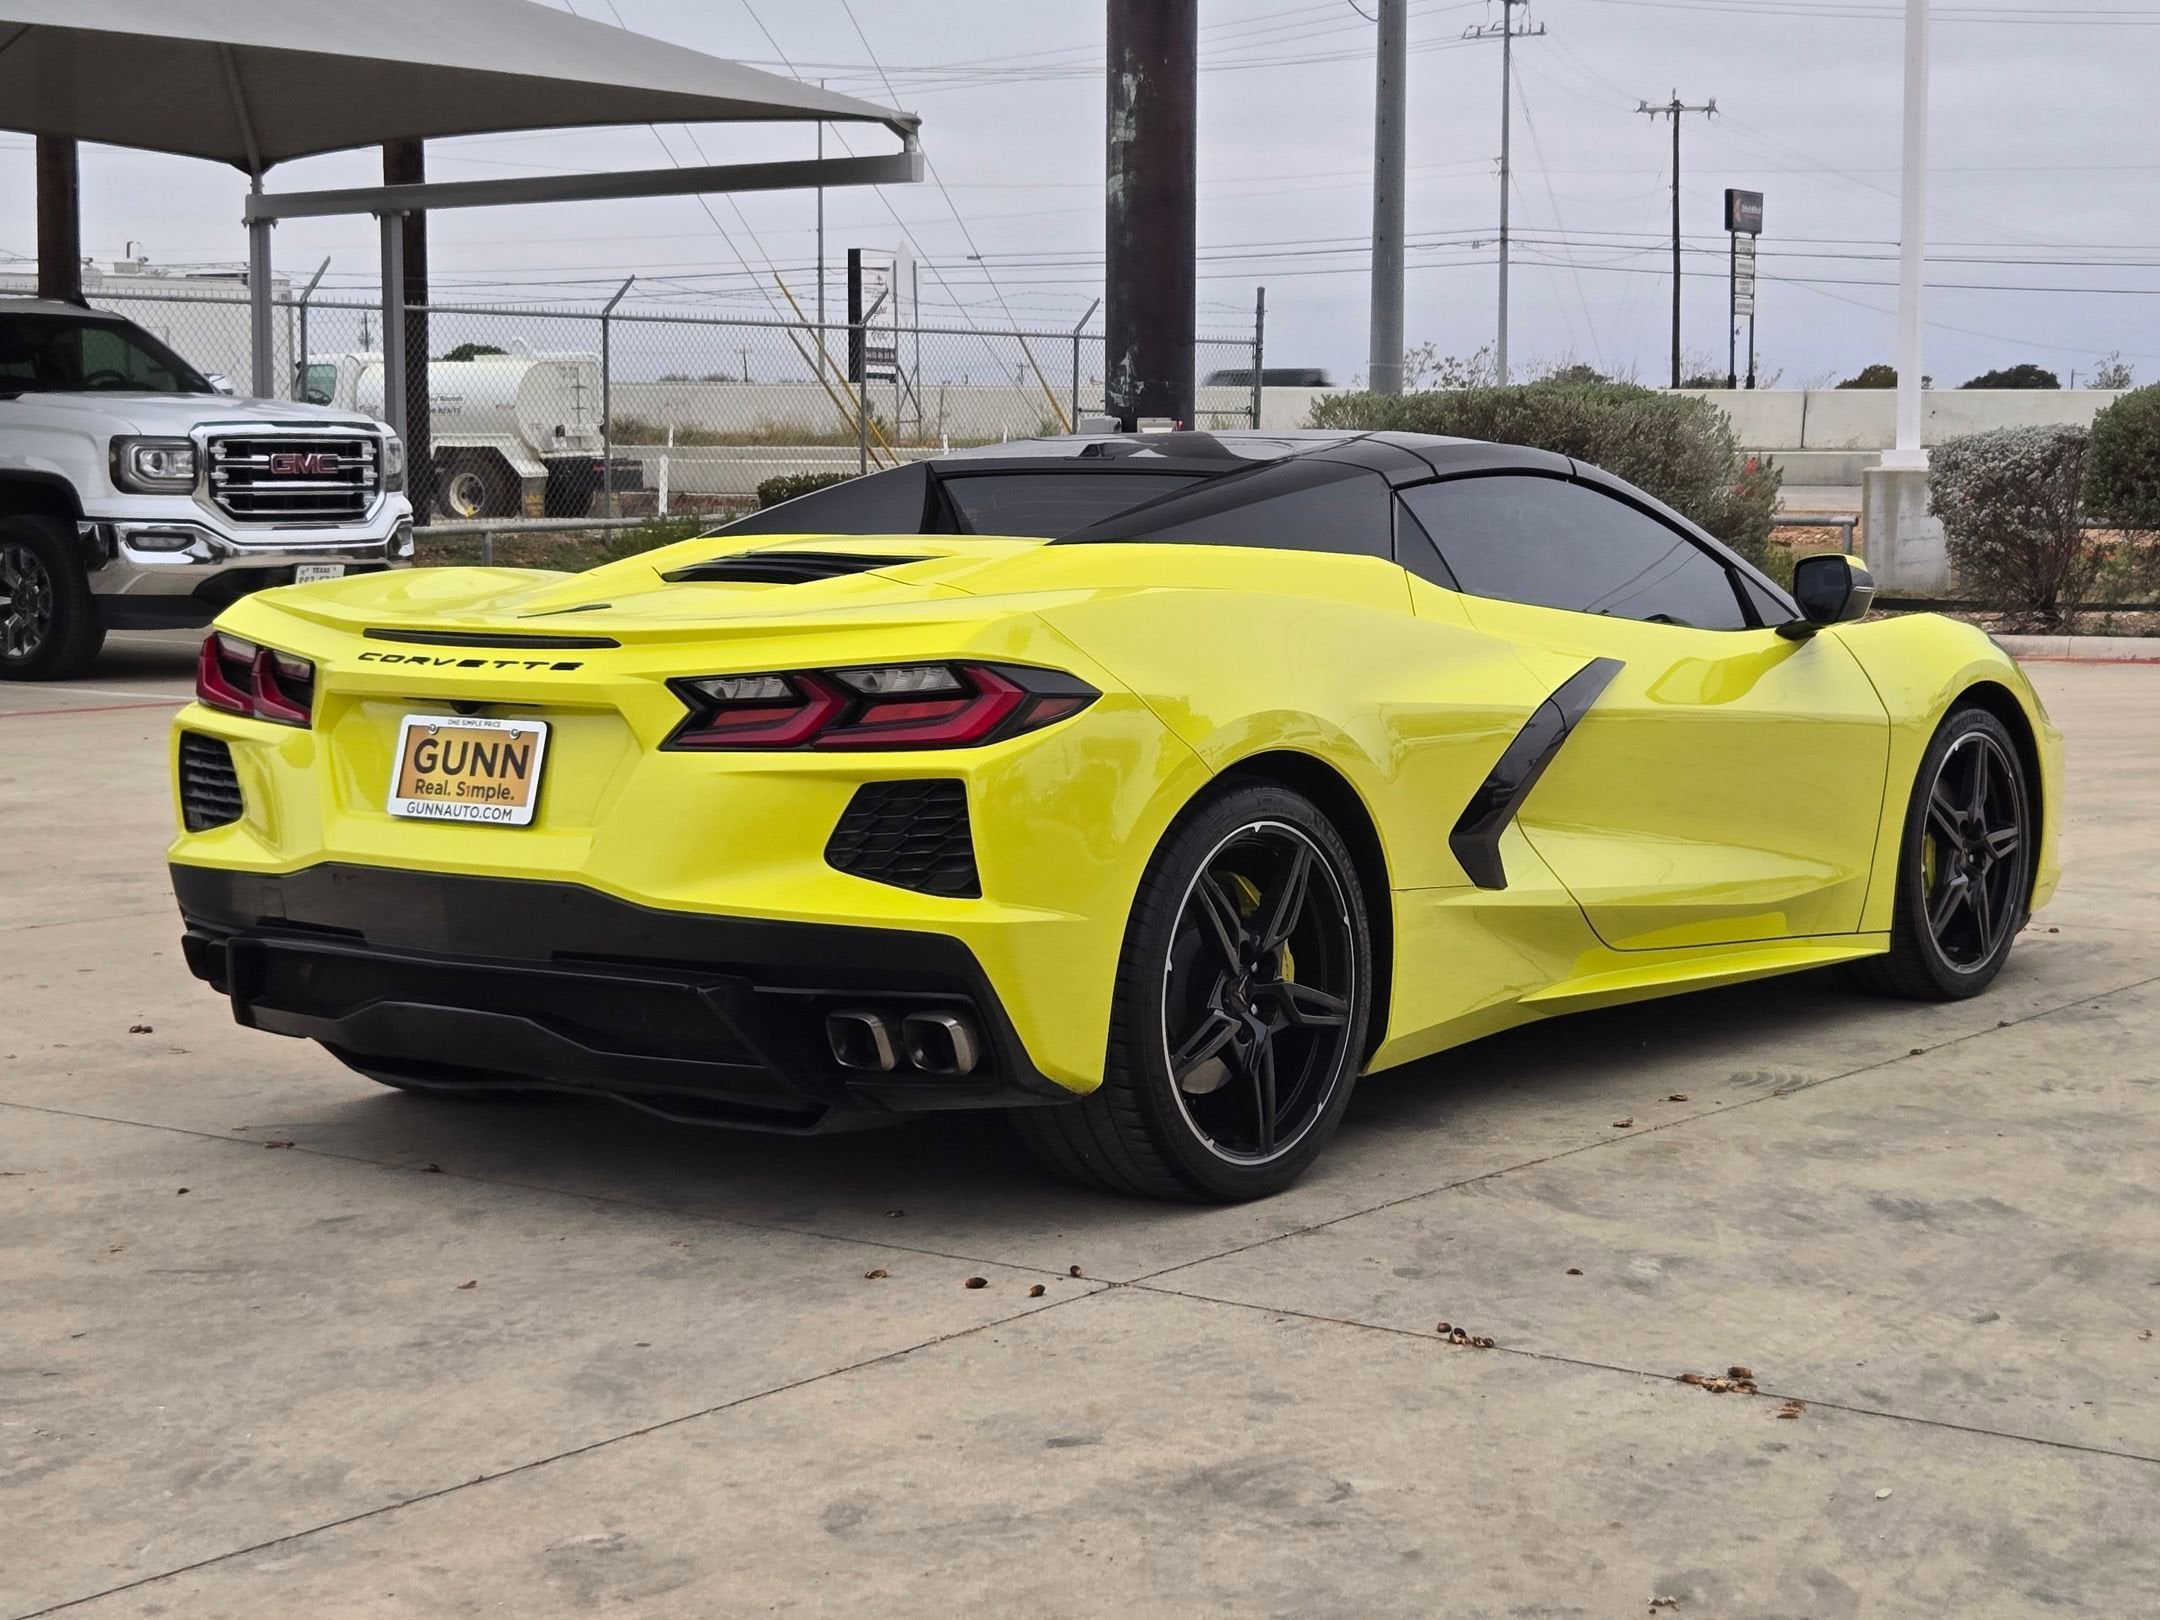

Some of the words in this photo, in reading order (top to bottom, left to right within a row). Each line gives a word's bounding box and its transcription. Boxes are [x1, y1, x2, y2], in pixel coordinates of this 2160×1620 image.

[271, 453, 340, 474] GMC
[358, 652, 584, 670] CORVETTE
[414, 738, 529, 779] GUNN
[415, 779, 451, 795] Real.
[406, 802, 512, 821] GUNNAUTO.COM
